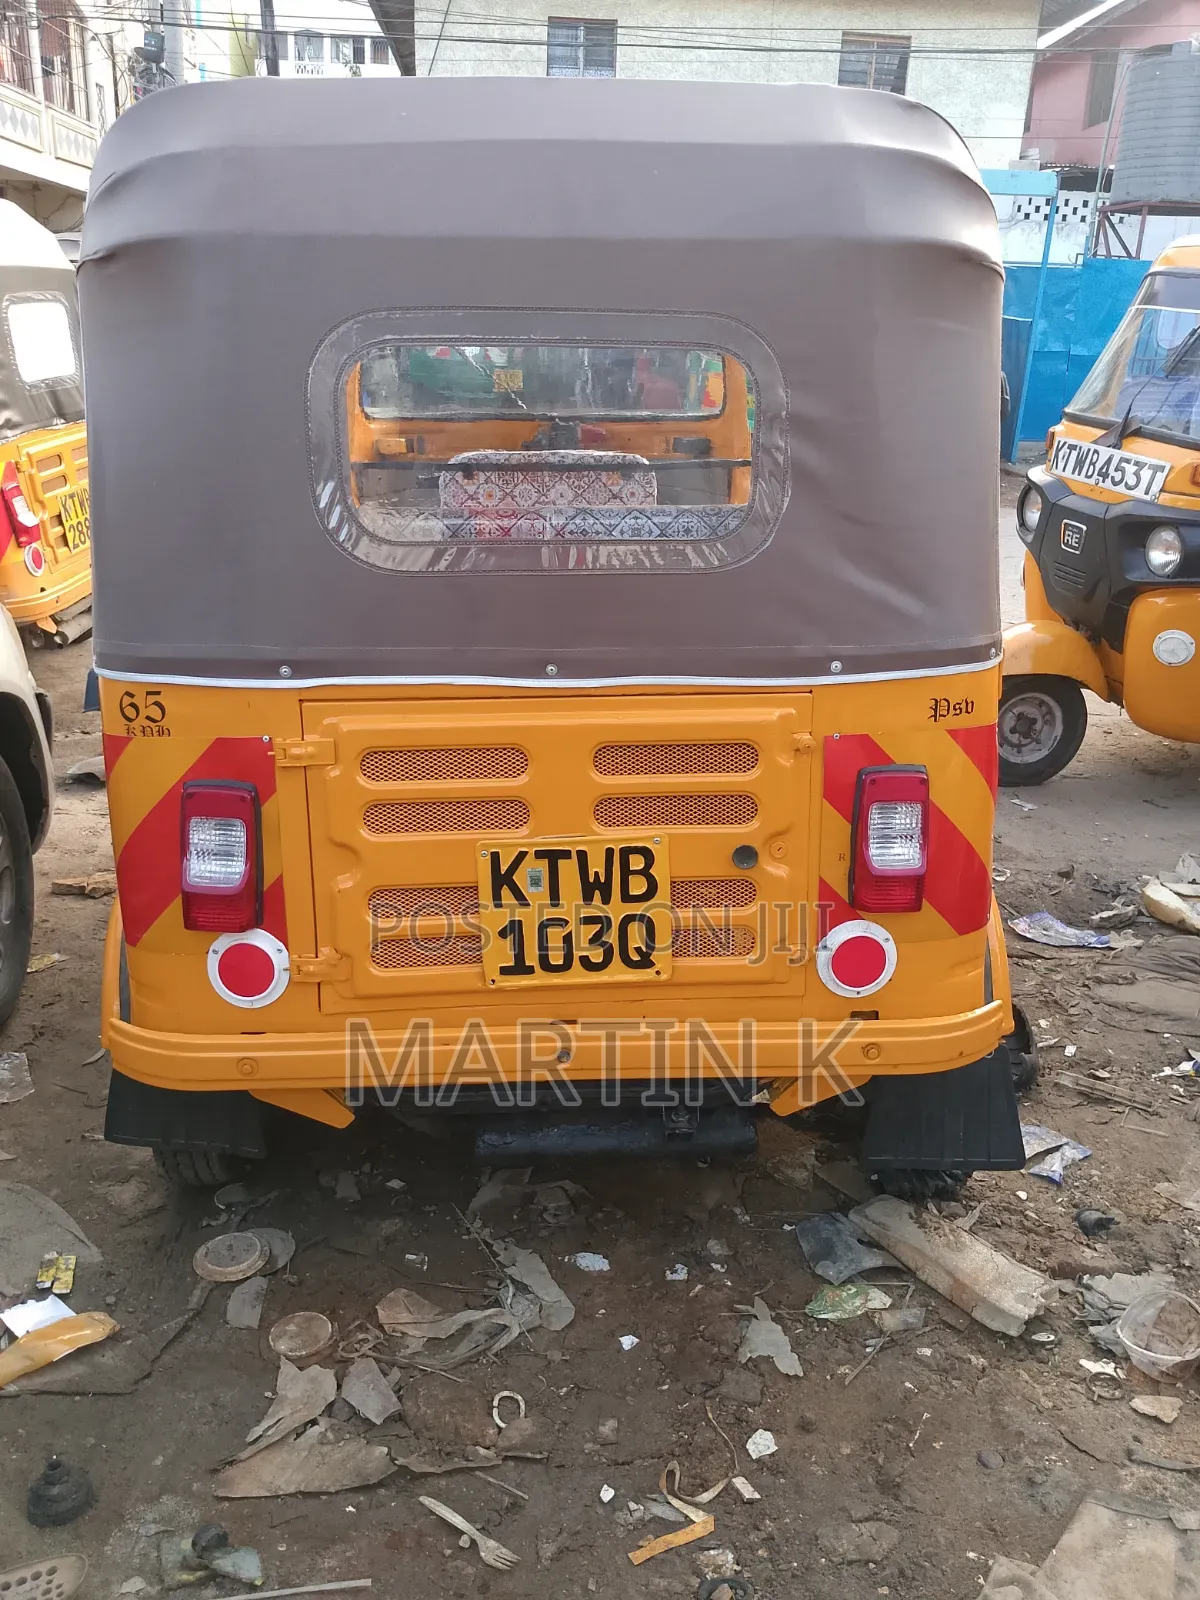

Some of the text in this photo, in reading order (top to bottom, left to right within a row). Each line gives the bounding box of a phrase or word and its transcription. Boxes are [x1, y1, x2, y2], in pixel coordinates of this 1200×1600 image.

[1065, 530, 1080, 547] RE
[119, 690, 166, 724] 65
[489, 845, 659, 908] KTWB
[497, 913, 656, 975] 103Q
